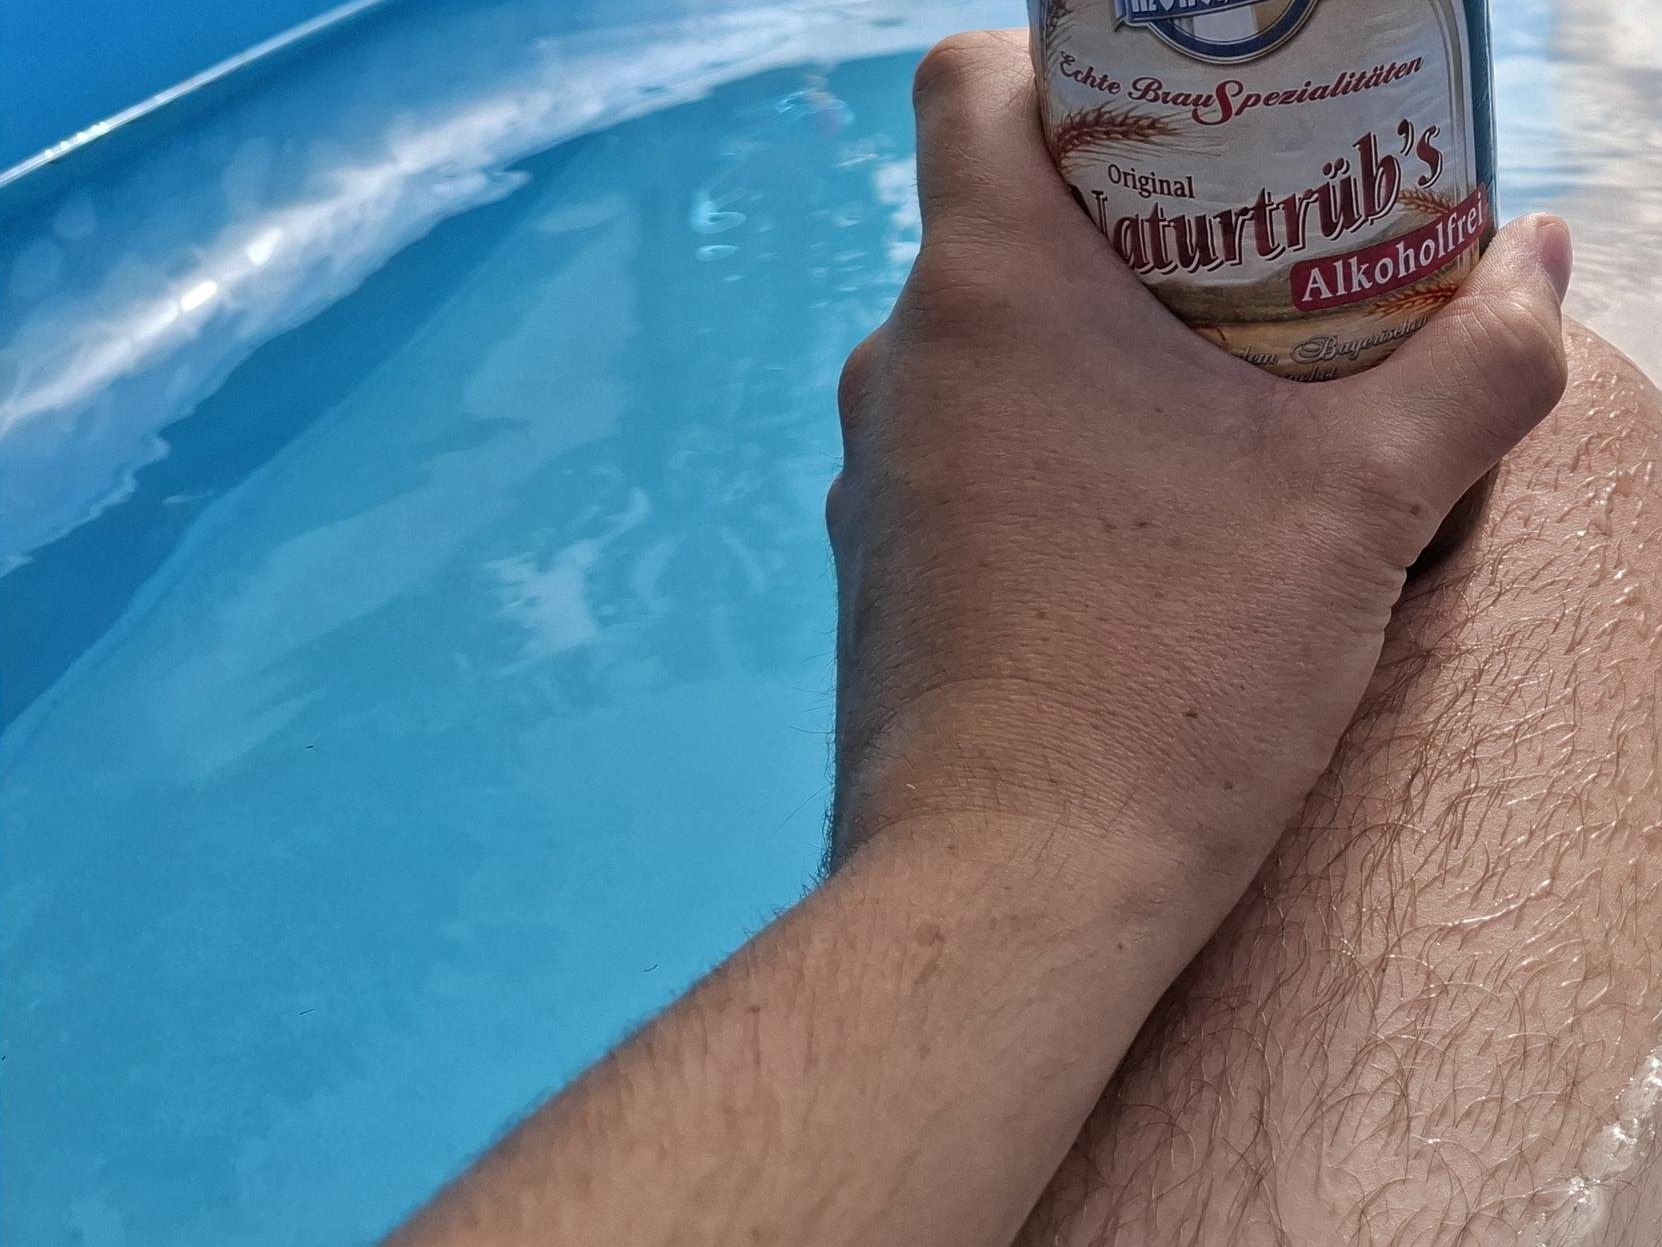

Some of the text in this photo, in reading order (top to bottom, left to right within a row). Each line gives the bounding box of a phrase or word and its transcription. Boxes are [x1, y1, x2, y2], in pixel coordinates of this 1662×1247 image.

[1060, 51, 1121, 95] Echte
[1108, 163, 1196, 199] Original
[1301, 191, 1485, 302] Alkoholfrei
